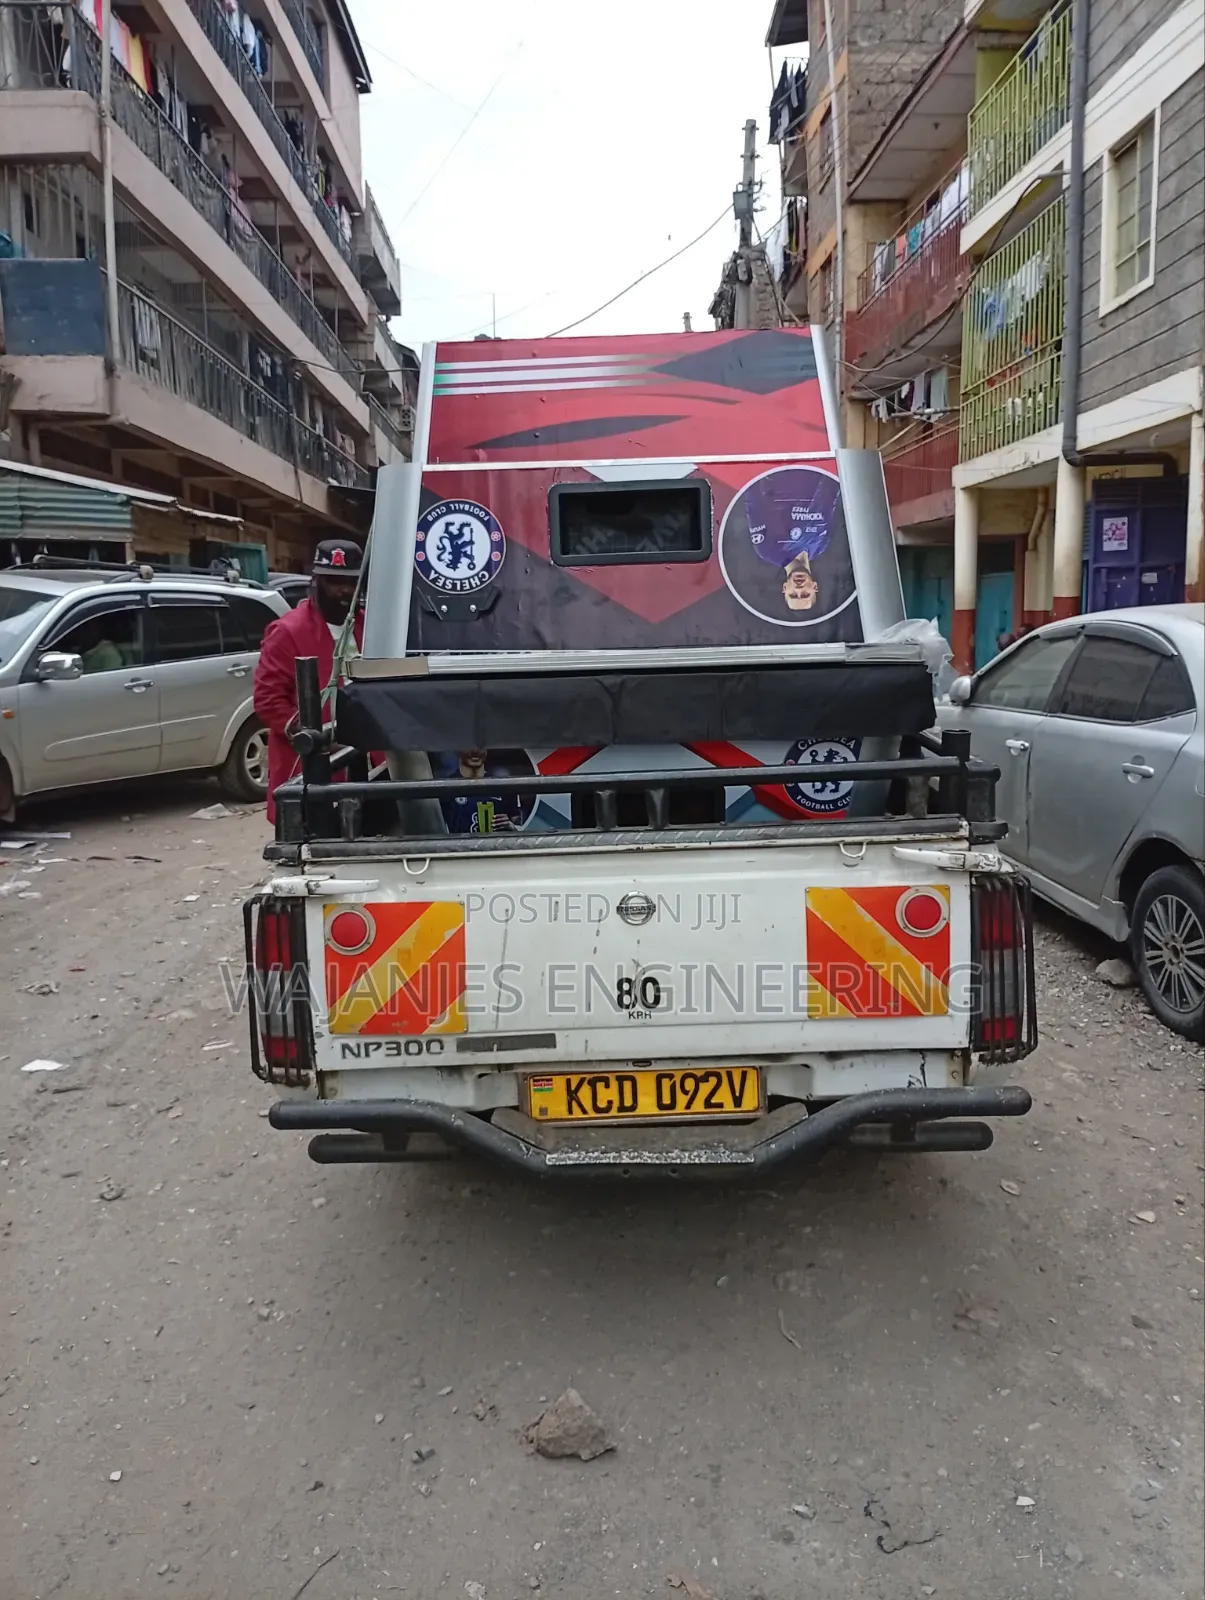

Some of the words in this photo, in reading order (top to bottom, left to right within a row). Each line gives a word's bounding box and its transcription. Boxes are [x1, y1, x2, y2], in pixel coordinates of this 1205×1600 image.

[426, 506, 447, 522] CLUB
[450, 503, 490, 522] FOOTBALL
[791, 512, 823, 521] YOKOHAMA
[428, 569, 489, 591] CHELSEA
[796, 795, 834, 810] FOOTBALL
[616, 976, 661, 1010] 80
[341, 1038, 445, 1060] NP300
[565, 1075, 638, 1115] KCD
[655, 1070, 748, 1111] 092V
